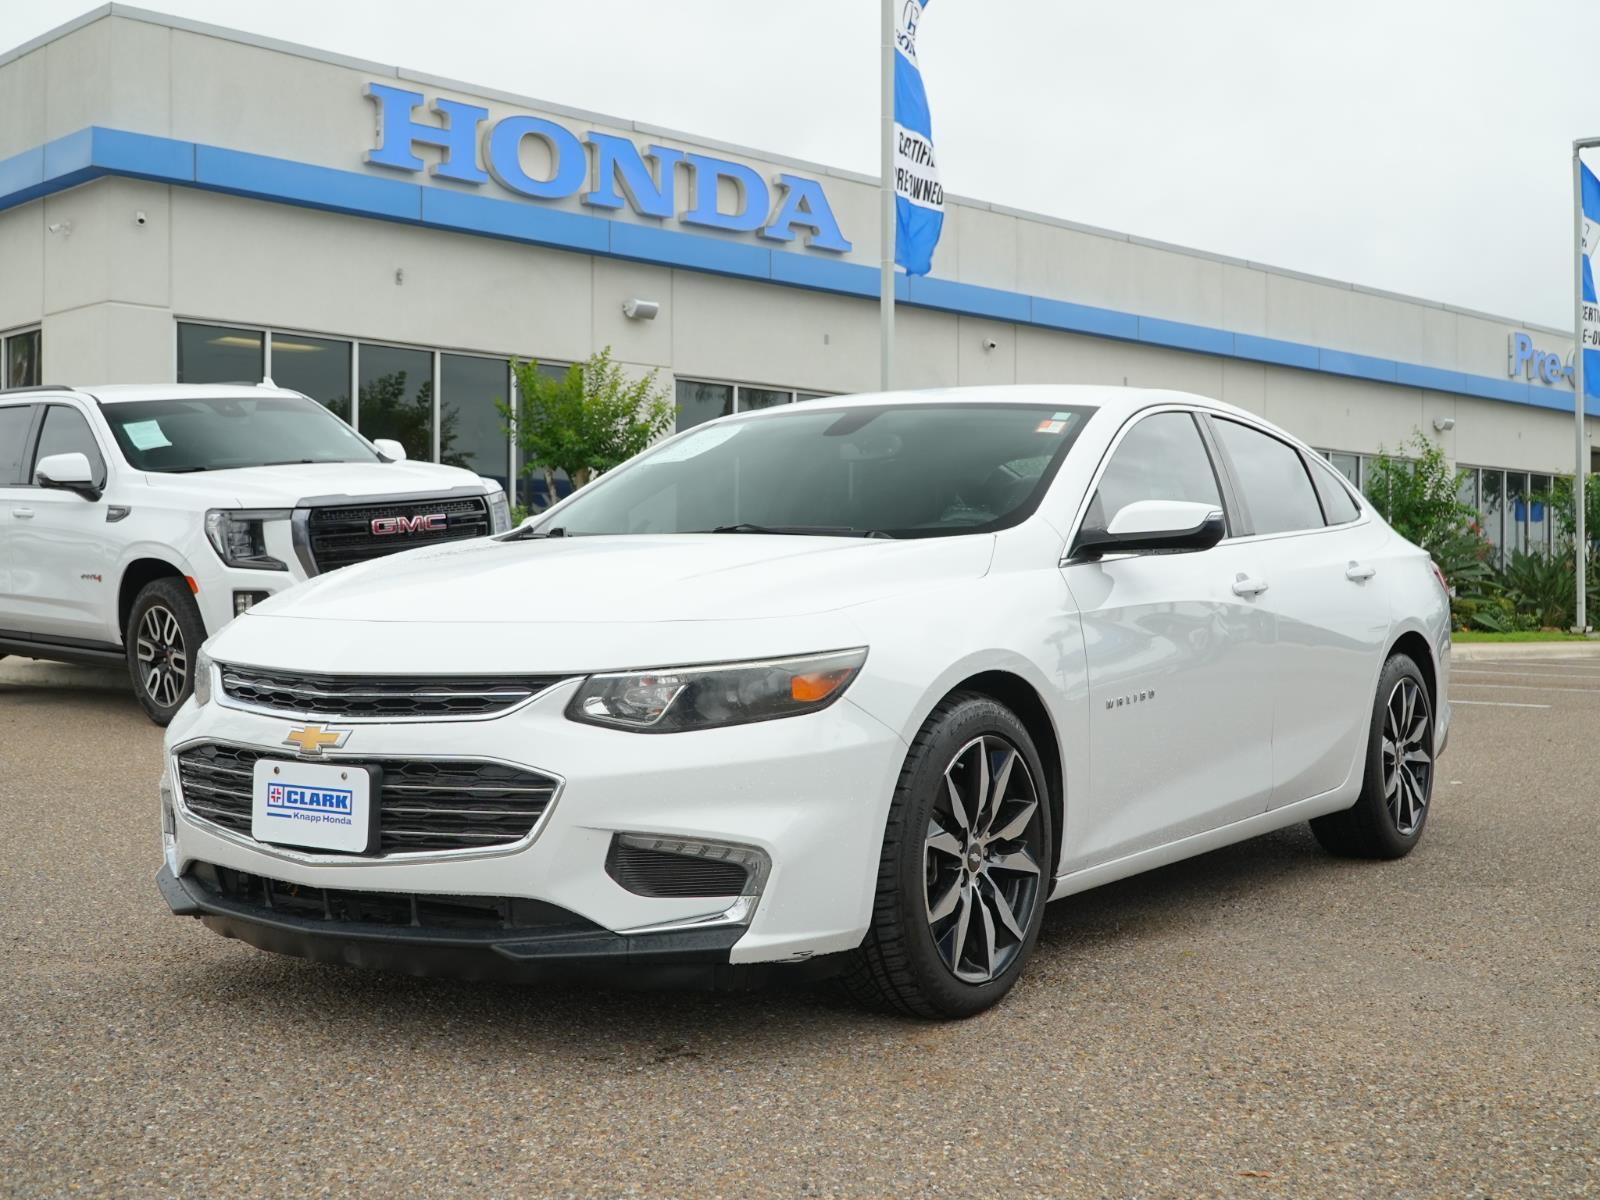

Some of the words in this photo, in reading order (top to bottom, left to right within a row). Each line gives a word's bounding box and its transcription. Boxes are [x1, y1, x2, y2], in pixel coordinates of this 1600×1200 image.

[364, 82, 852, 253] HONDA
[1511, 332, 1575, 389] Pre-
[371, 513, 448, 535] GMC
[286, 790, 348, 809] CLARK
[293, 812, 321, 824] Knapp
[322, 815, 352, 825] Honda
